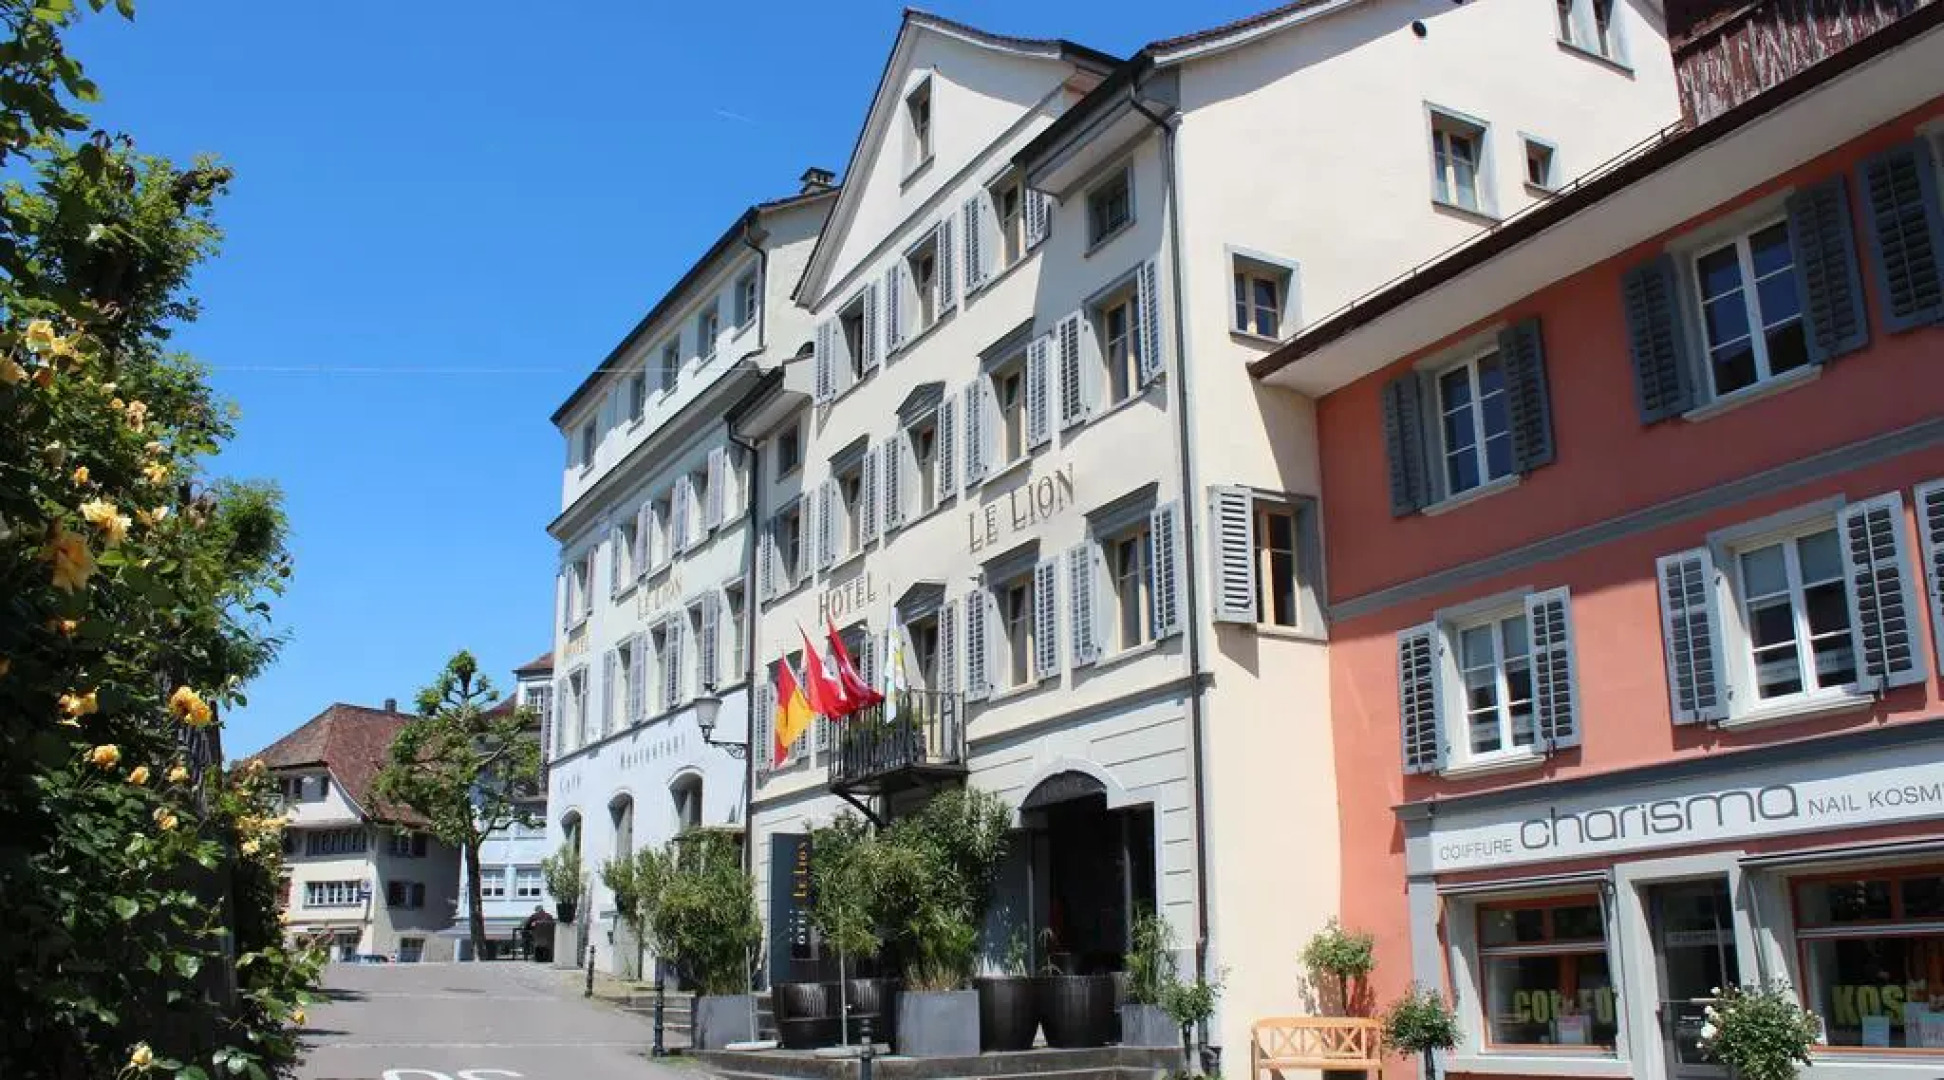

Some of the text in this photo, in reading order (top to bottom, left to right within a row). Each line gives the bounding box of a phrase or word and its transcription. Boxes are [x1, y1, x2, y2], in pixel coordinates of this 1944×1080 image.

[969, 462, 1075, 554] LE LION
[818, 571, 876, 627] HOTEL
[1440, 838, 1513, 861] COIFFURE
[1520, 783, 1800, 850] charisma
[1807, 794, 1862, 817] NAIL
